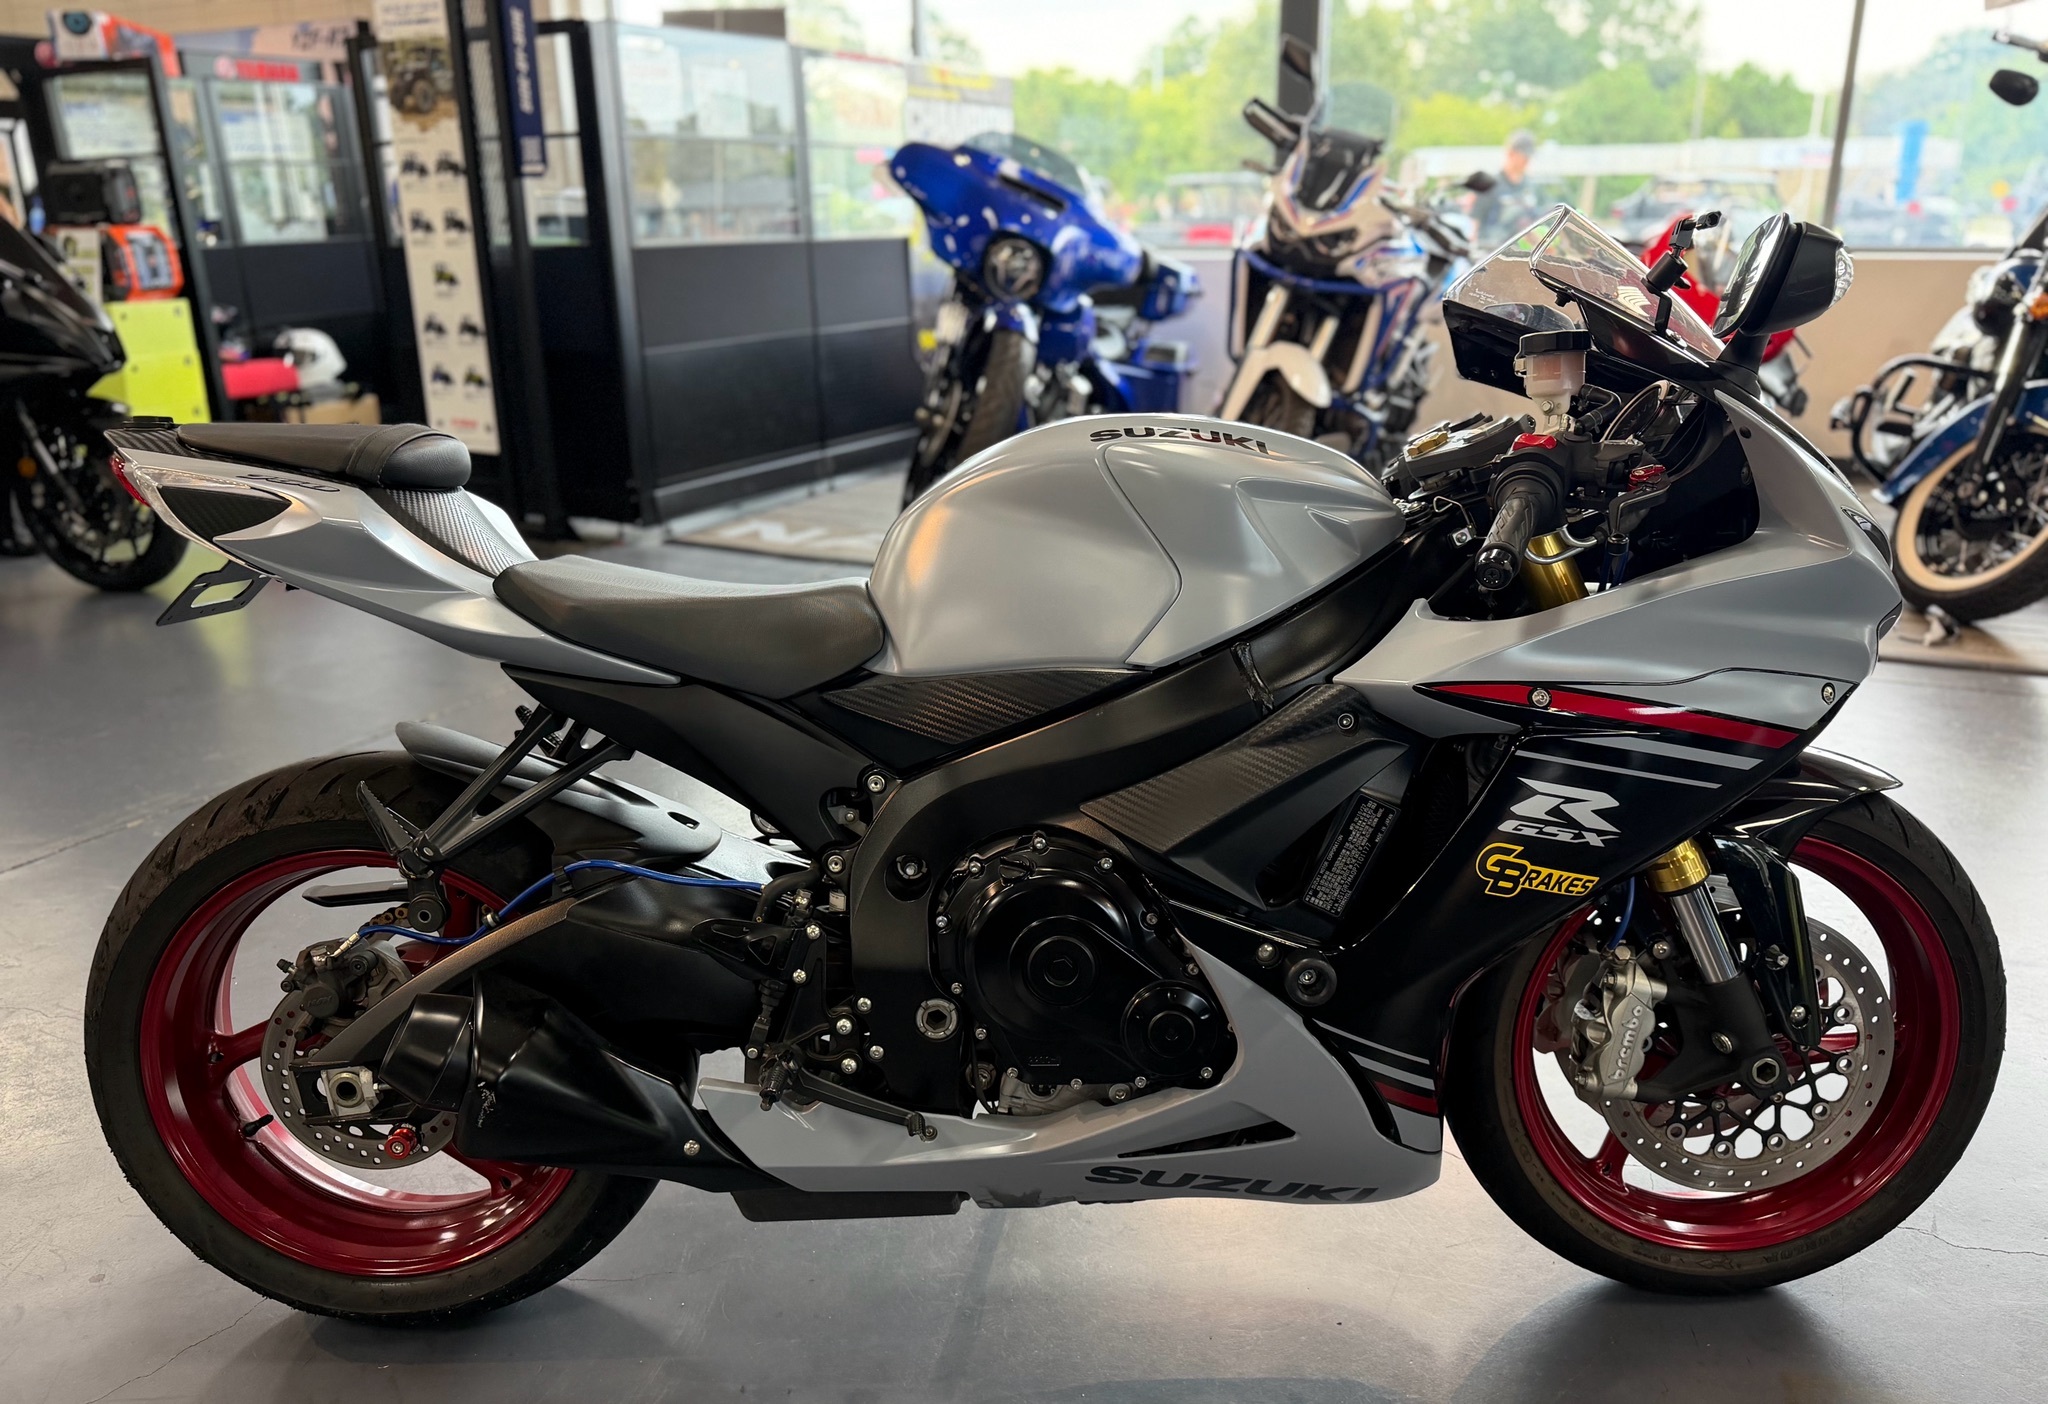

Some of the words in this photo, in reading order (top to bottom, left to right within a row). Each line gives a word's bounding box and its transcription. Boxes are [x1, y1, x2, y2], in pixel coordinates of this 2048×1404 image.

[1089, 427, 1269, 455] SUZUKI
[1510, 777, 1621, 833] R
[1497, 819, 1622, 847] GSX
[1608, 1005, 1644, 1080] brembo
[1085, 1165, 1379, 1202] SUZUKI
